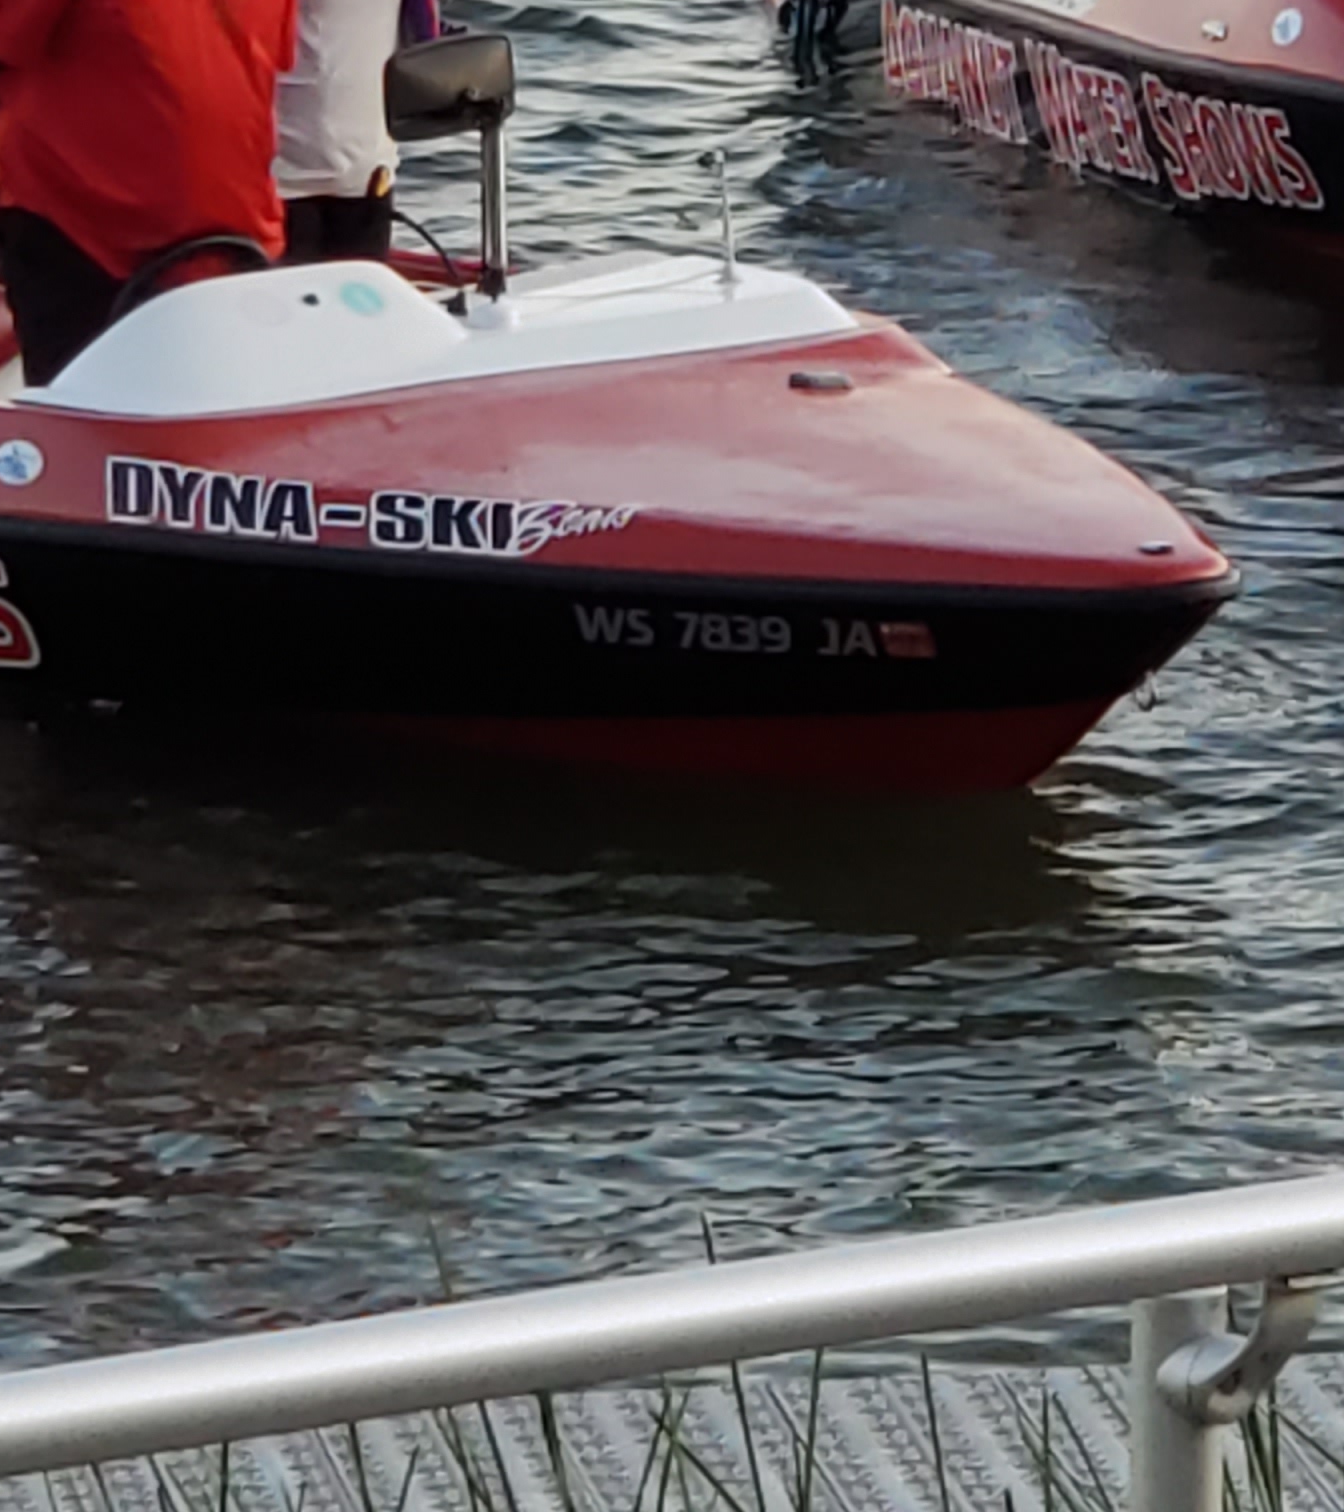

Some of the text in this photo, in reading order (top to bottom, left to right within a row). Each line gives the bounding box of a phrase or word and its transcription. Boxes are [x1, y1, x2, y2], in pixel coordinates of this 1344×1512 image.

[1141, 71, 1325, 211] SHOWS
[106, 455, 521, 557] DYNA-SKI
[573, 601, 878, 657] WS 7839 JA
